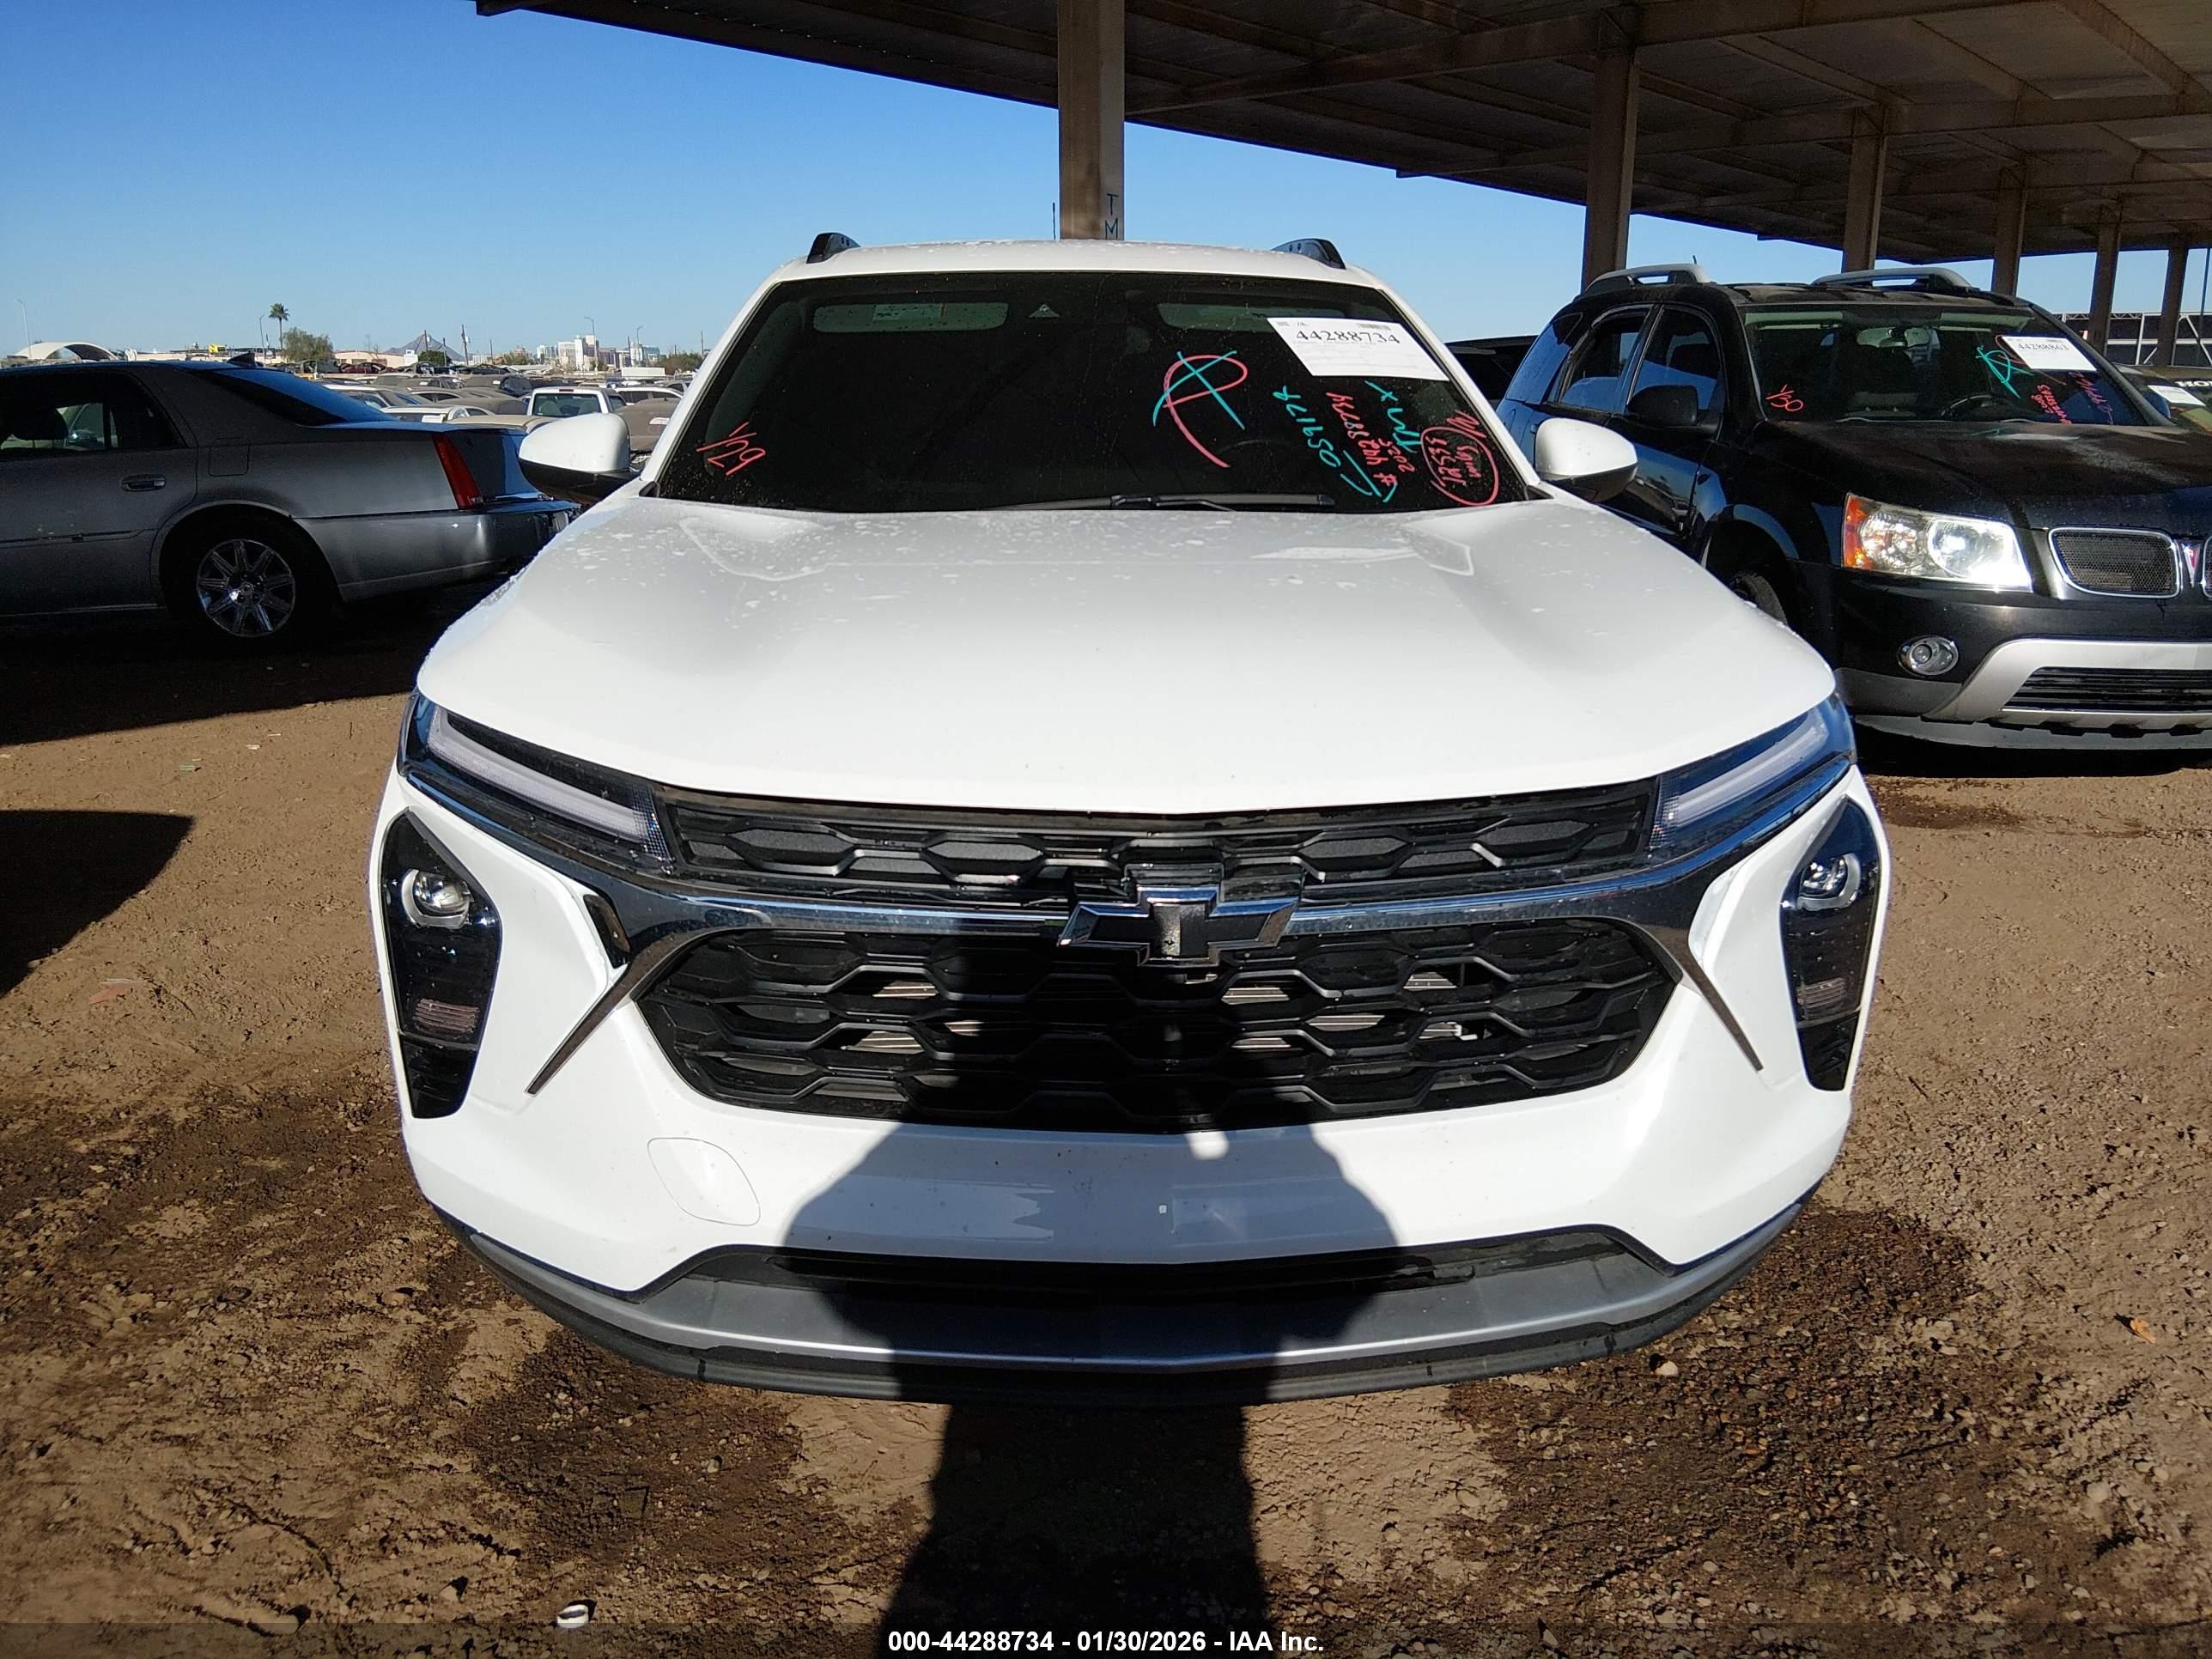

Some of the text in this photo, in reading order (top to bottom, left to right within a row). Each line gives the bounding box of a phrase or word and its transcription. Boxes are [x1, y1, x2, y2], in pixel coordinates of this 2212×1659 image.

[1297, 330, 1401, 343] 44288734
[1765, 384, 1804, 412] 1/30
[696, 421, 767, 477] 1/29
